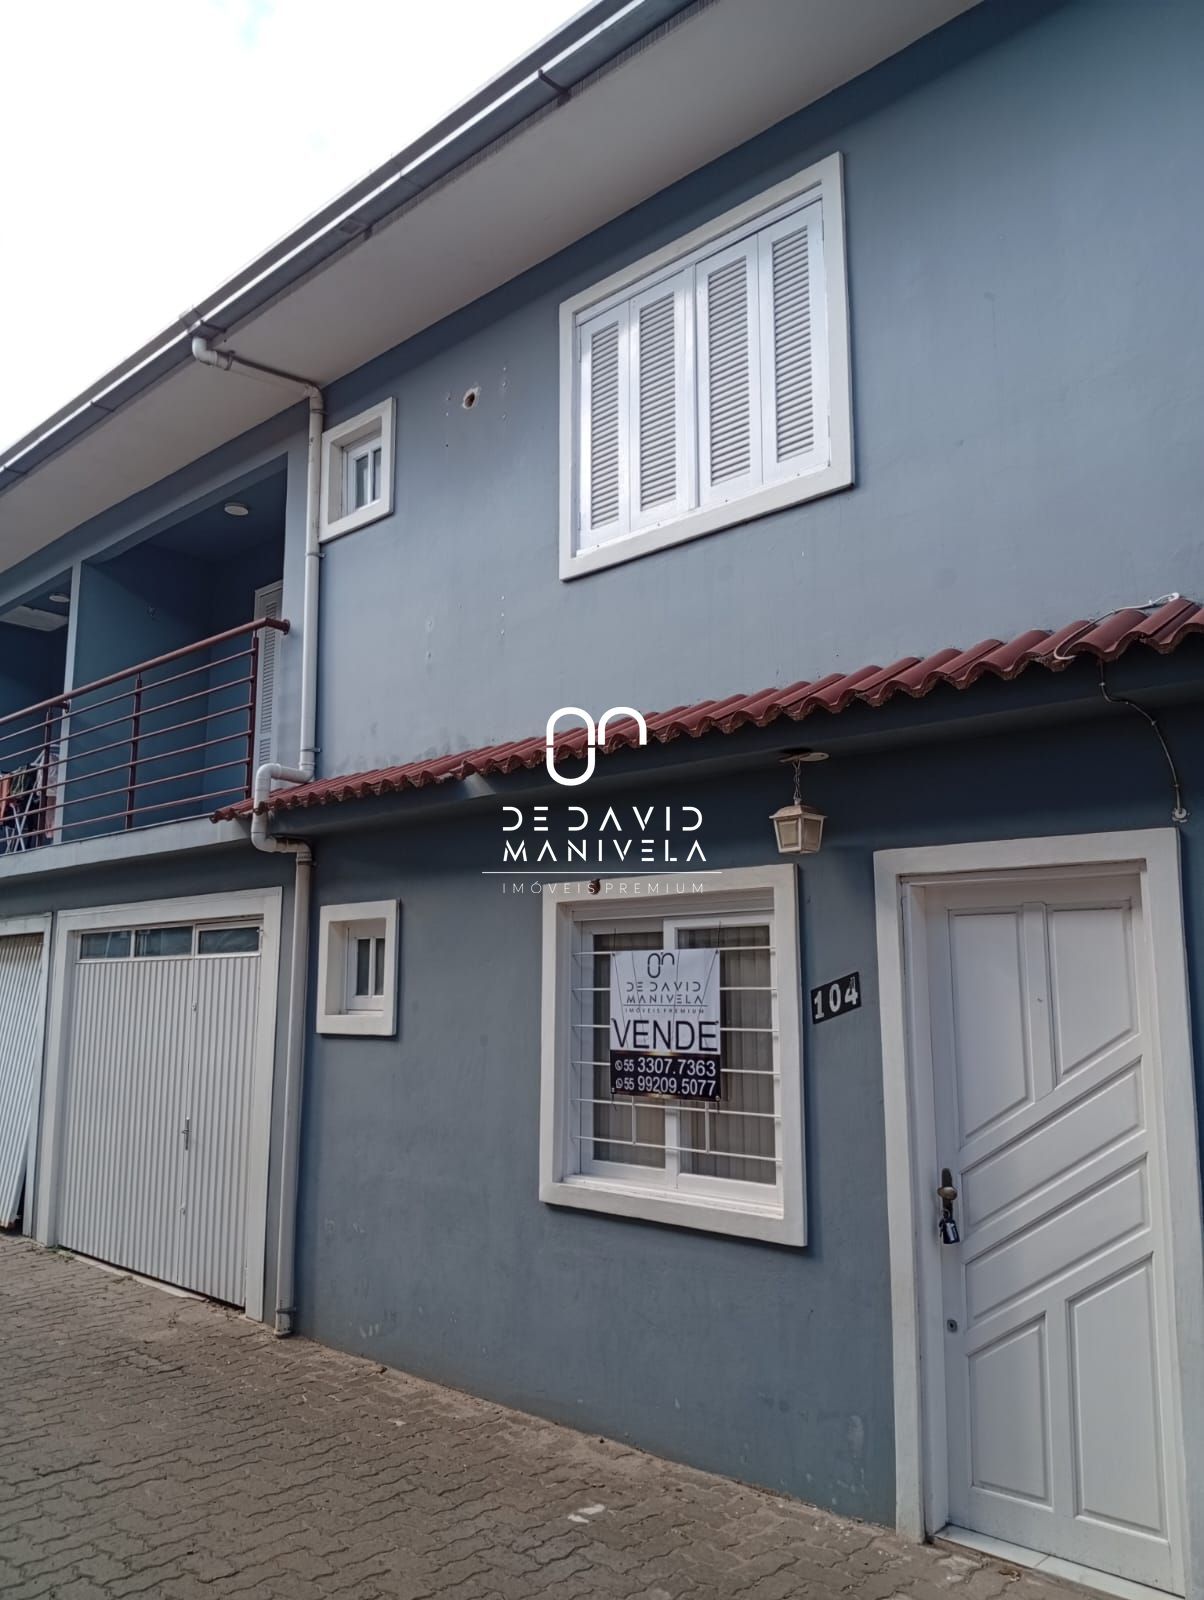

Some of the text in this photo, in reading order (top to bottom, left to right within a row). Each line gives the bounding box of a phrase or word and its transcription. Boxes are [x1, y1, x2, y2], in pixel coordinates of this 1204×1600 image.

[627, 981, 702, 992] DE DAVID
[626, 994, 704, 1004] MANIVELA
[814, 975, 859, 1019] 104
[611, 1018, 719, 1052] VENDE
[623, 1057, 716, 1077] 55 3307.7363
[624, 1076, 716, 1096] 55 99209.5077
